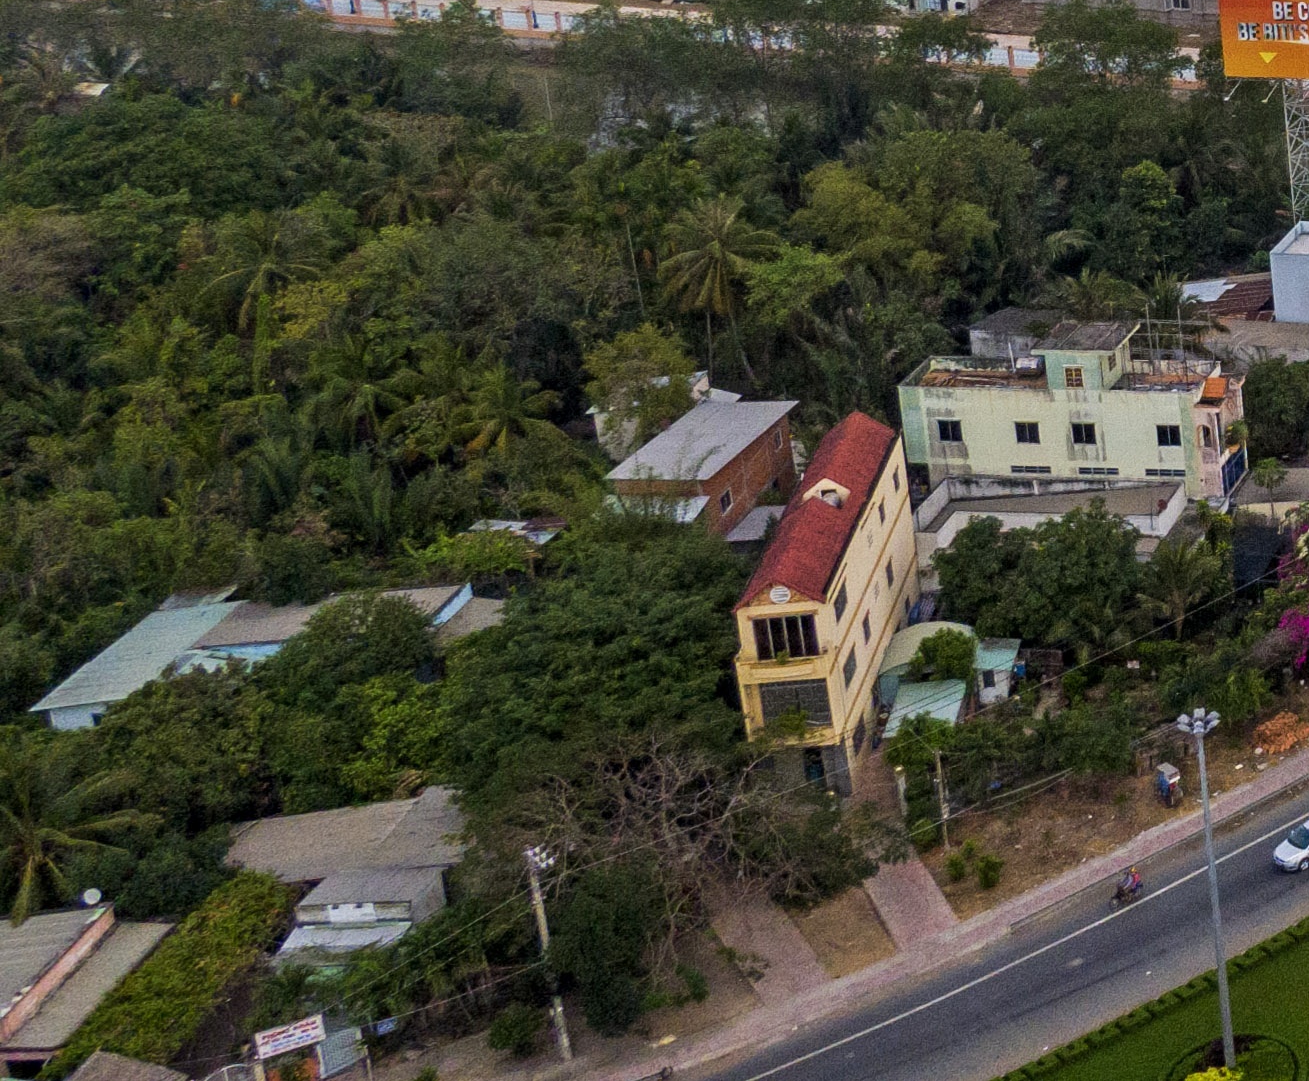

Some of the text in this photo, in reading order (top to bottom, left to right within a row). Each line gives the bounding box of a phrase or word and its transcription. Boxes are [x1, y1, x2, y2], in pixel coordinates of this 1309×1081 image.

[1272, 1, 1294, 20] BE
[1237, 22, 1260, 41] BE
[1263, 23, 1308, 41] BITI'S
